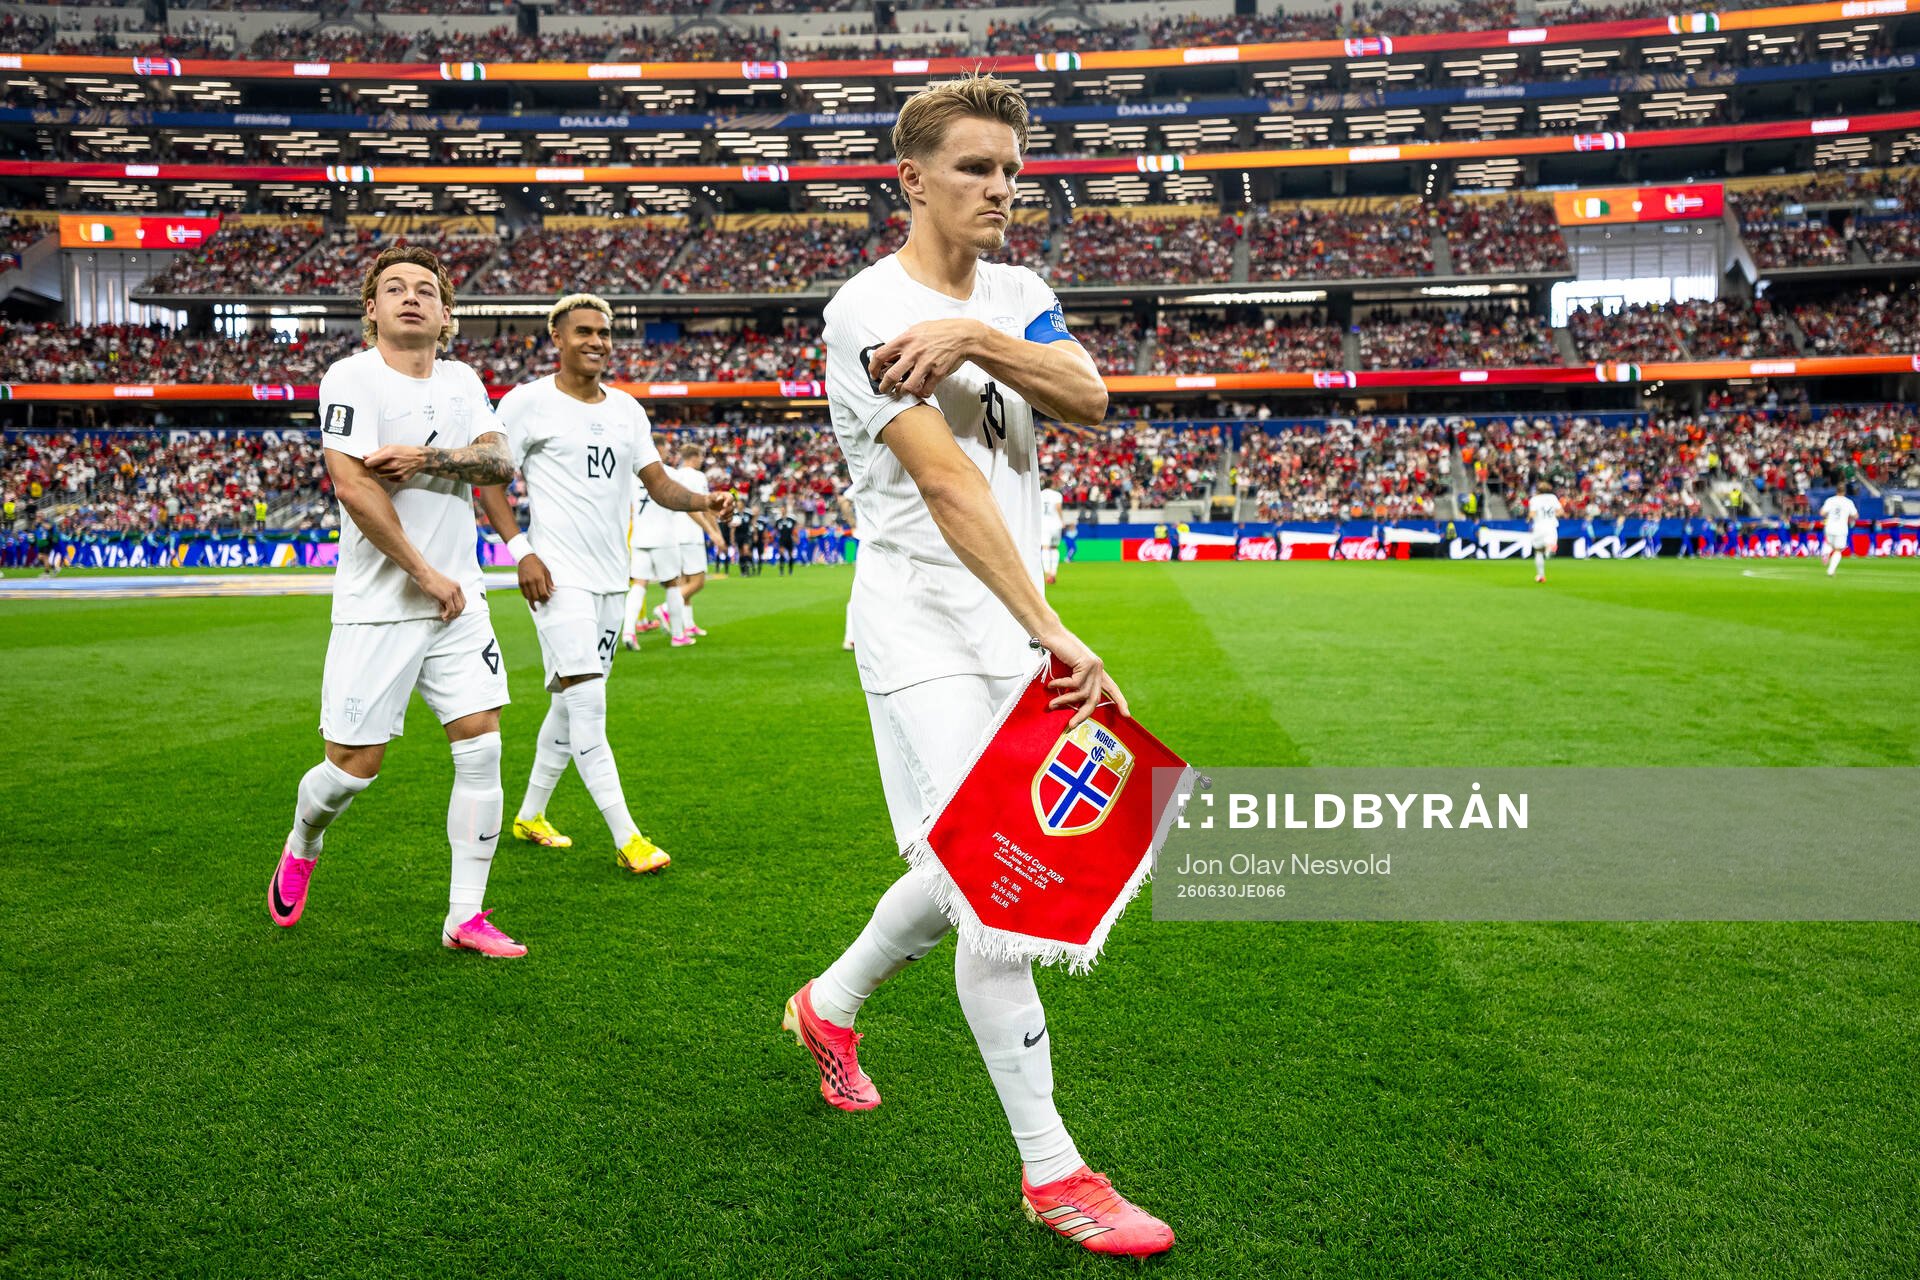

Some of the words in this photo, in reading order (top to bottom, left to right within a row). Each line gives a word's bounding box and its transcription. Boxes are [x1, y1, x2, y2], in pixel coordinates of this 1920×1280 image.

[1831, 55, 1915, 73] DALLAS
[560, 116, 629, 127] DALLAS
[1117, 103, 1187, 116] DALLAS
[587, 445, 616, 479] 20
[482, 638, 499, 675] 6
[1094, 729, 1117, 751] NORGE
[992, 832, 1010, 847] FIFA
[1010, 843, 1033, 862] World
[1031, 858, 1047, 873] Cup
[1046, 869, 1065, 884] 2026
[993, 851, 1014, 870] Canada,
[1014, 866, 1033, 882] Mexico,
[1033, 879, 1047, 891] USA
[1009, 854, 1023, 866] June
[1037, 873, 1050, 885] July
[990, 892, 1010, 909] DALLAS
